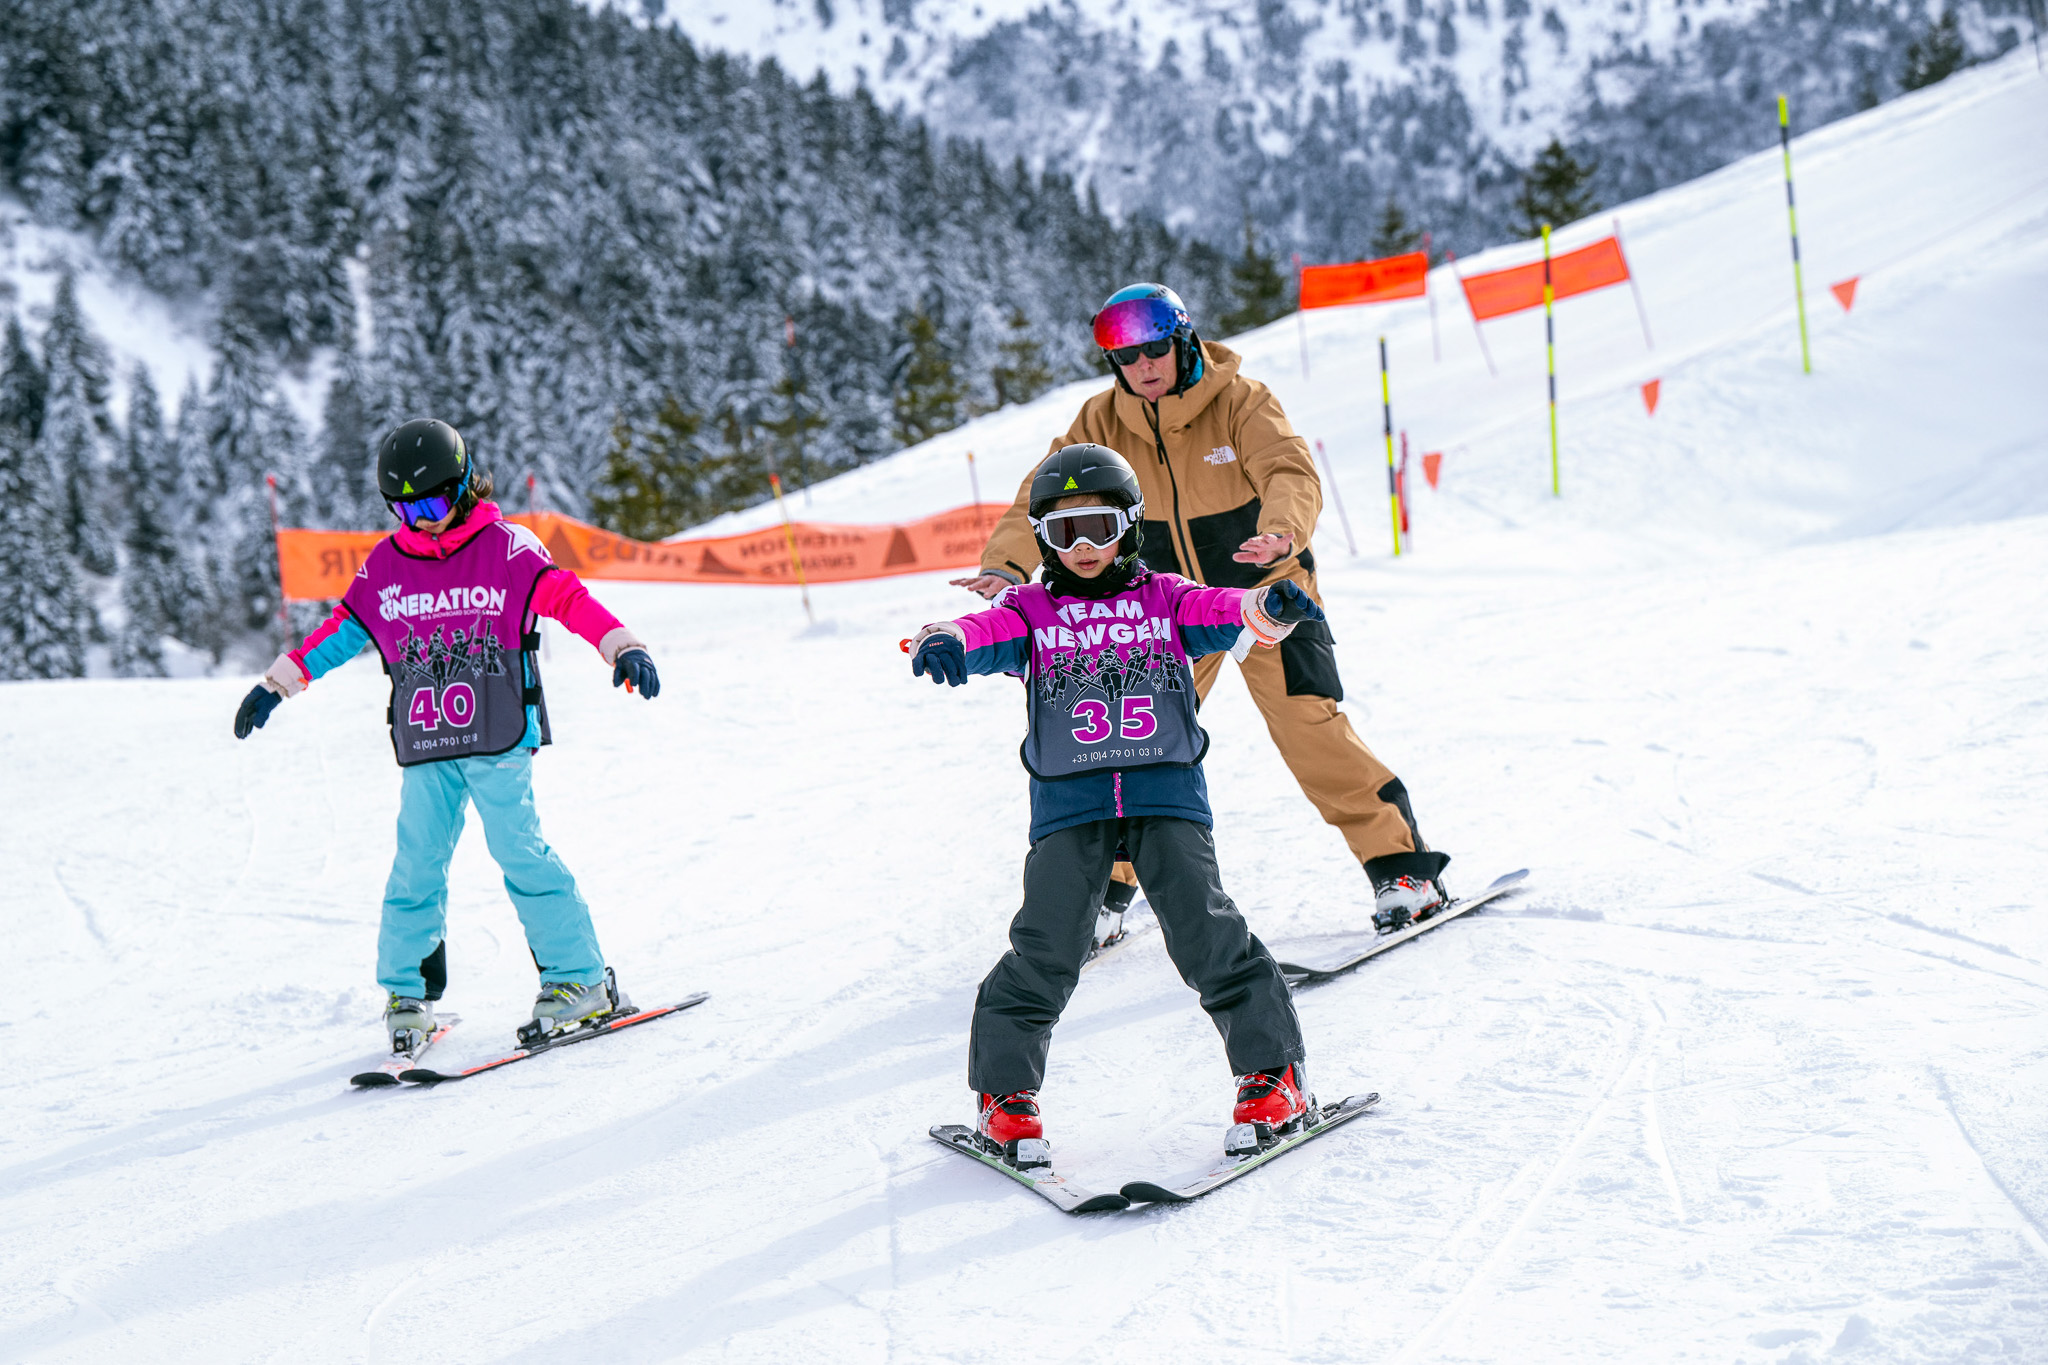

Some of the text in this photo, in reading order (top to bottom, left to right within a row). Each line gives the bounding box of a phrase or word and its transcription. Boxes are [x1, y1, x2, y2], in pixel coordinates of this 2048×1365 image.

[1203, 451, 1226, 463] NORTH
[1211, 447, 1224, 455] THE
[1211, 457, 1228, 466] FACE
[1056, 599, 1144, 626] TEAM
[1034, 617, 1172, 652] NEWGEN
[408, 682, 476, 732] 40
[1071, 694, 1158, 745] 35
[422, 738, 438, 751] (0)4
[439, 737, 449, 747] 79
[450, 736, 460, 746] 01
[1072, 747, 1164, 764] +33 (0)4 79 01 03 18
